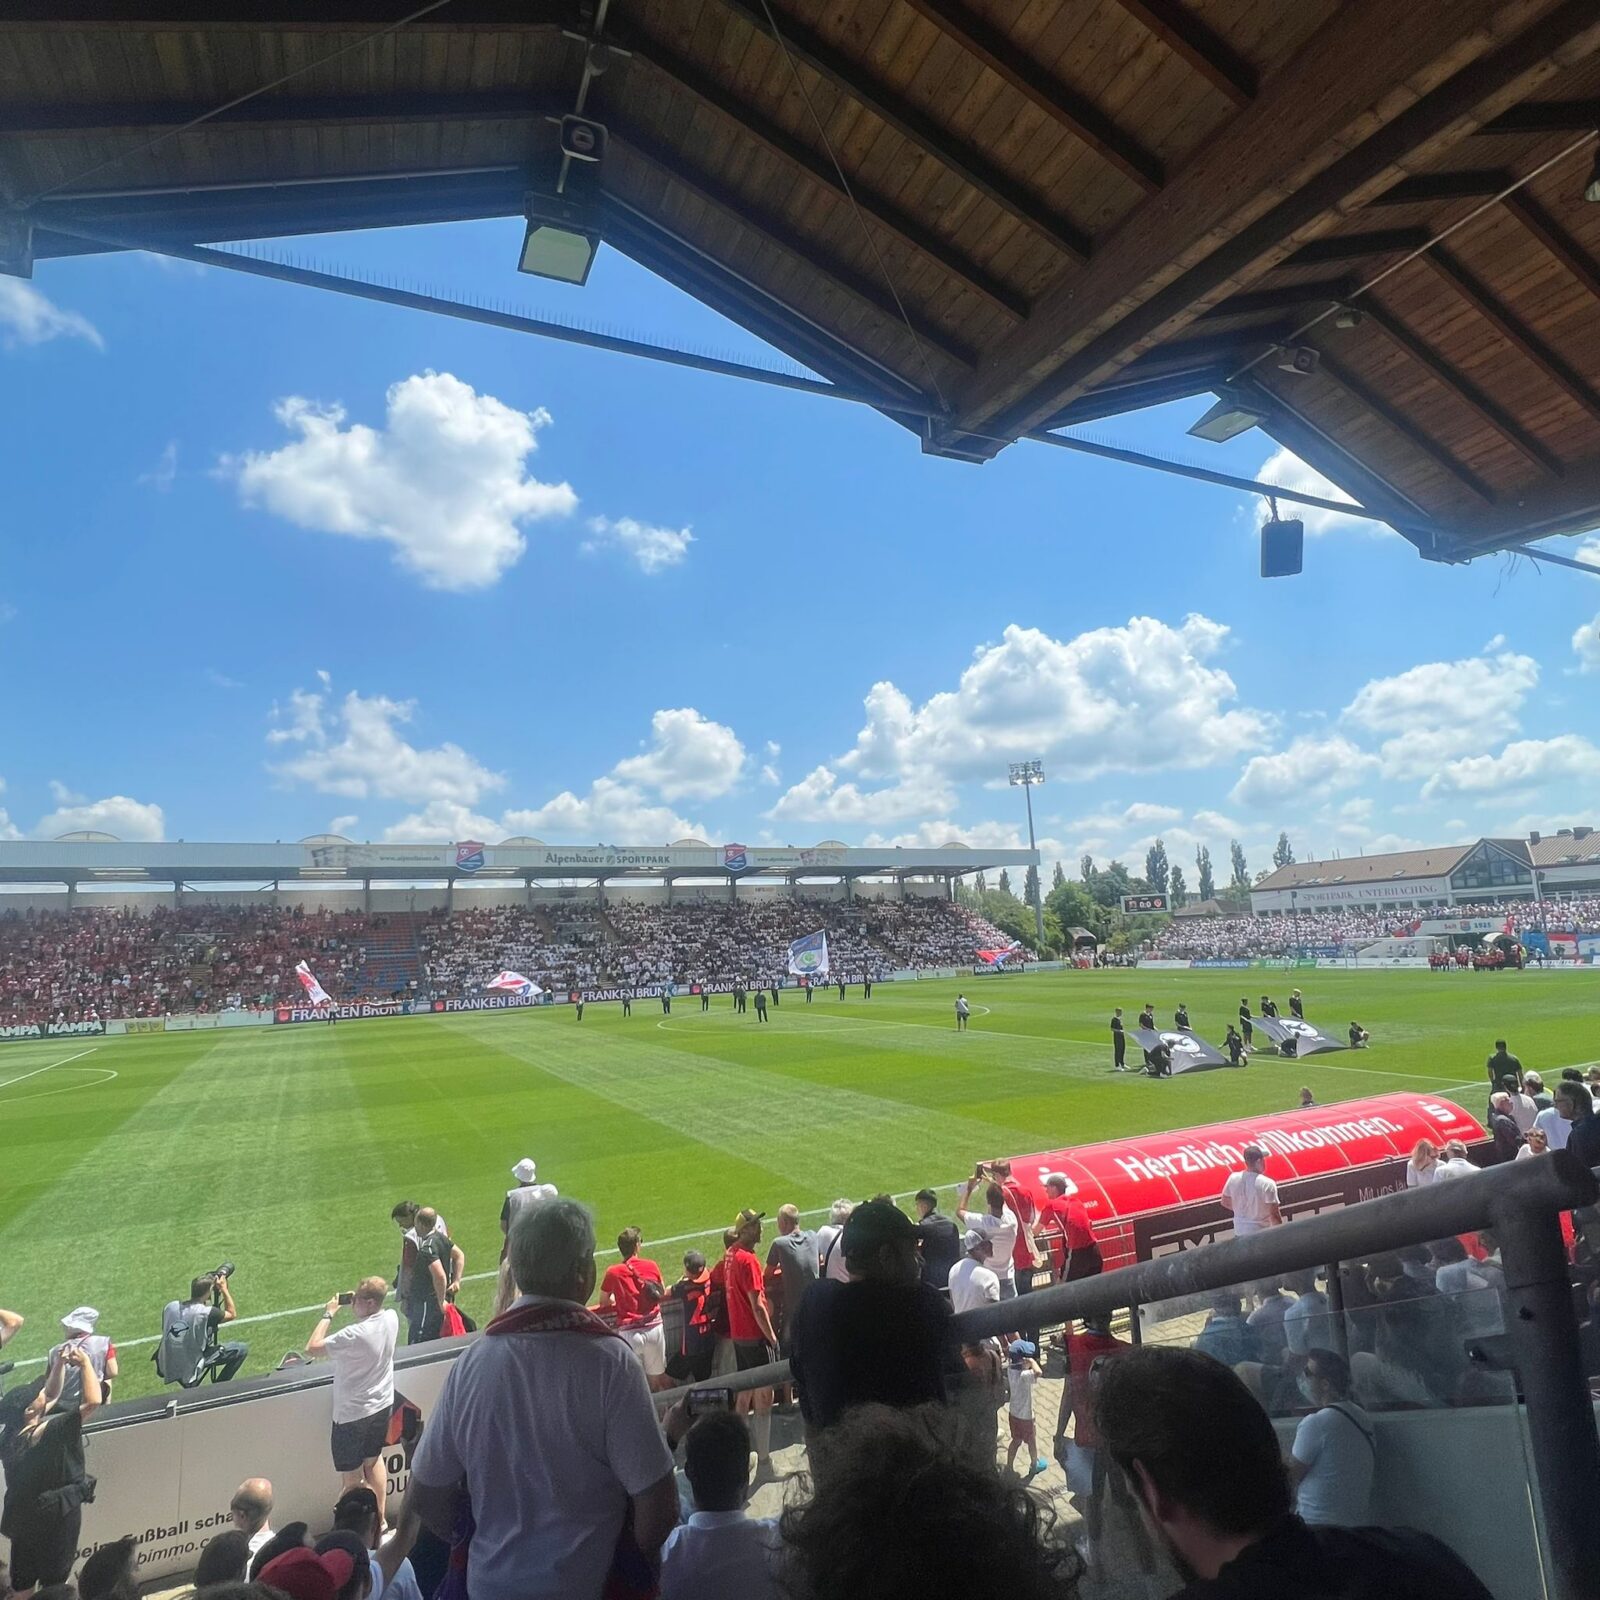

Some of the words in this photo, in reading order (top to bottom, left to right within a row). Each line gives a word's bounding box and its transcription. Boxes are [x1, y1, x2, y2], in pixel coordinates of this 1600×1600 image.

[545, 853, 604, 865] Alpenbauer
[616, 855, 670, 864] SPORTPARK
[1303, 890, 1353, 901] SPORTPARK
[1359, 885, 1437, 898] UNTERHACHING
[446, 996, 506, 1012] FRANKEN
[292, 1005, 360, 1021] FRANEN
[48, 1021, 102, 1034] KAMPA
[1114, 1141, 1246, 1182] Herzlich
[123, 1520, 189, 1547] ußball
